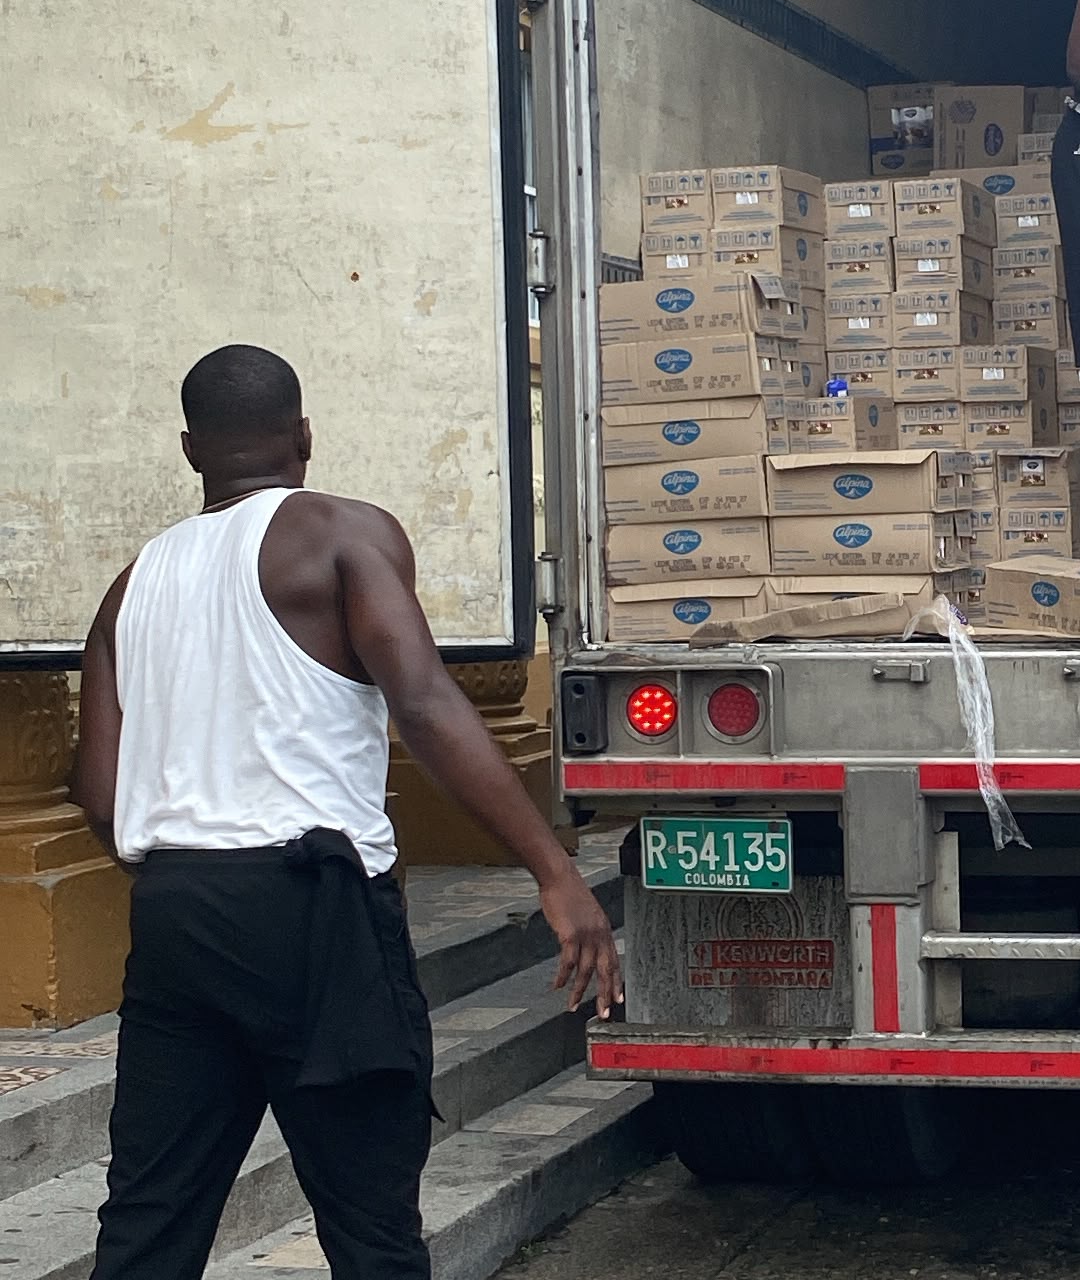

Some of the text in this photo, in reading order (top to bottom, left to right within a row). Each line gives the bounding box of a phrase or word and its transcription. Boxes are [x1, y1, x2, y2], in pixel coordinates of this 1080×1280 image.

[664, 423, 699, 436] Alpina
[663, 473, 698, 486] Alpina
[835, 477, 870, 491] Alpina
[665, 533, 700, 546] Alpina
[835, 527, 870, 541] Alpina
[684, 872, 751, 886] COLOMBIA
[716, 944, 830, 964] KENWORTH
[691, 972, 714, 986] DE
[719, 971, 738, 985] LA
